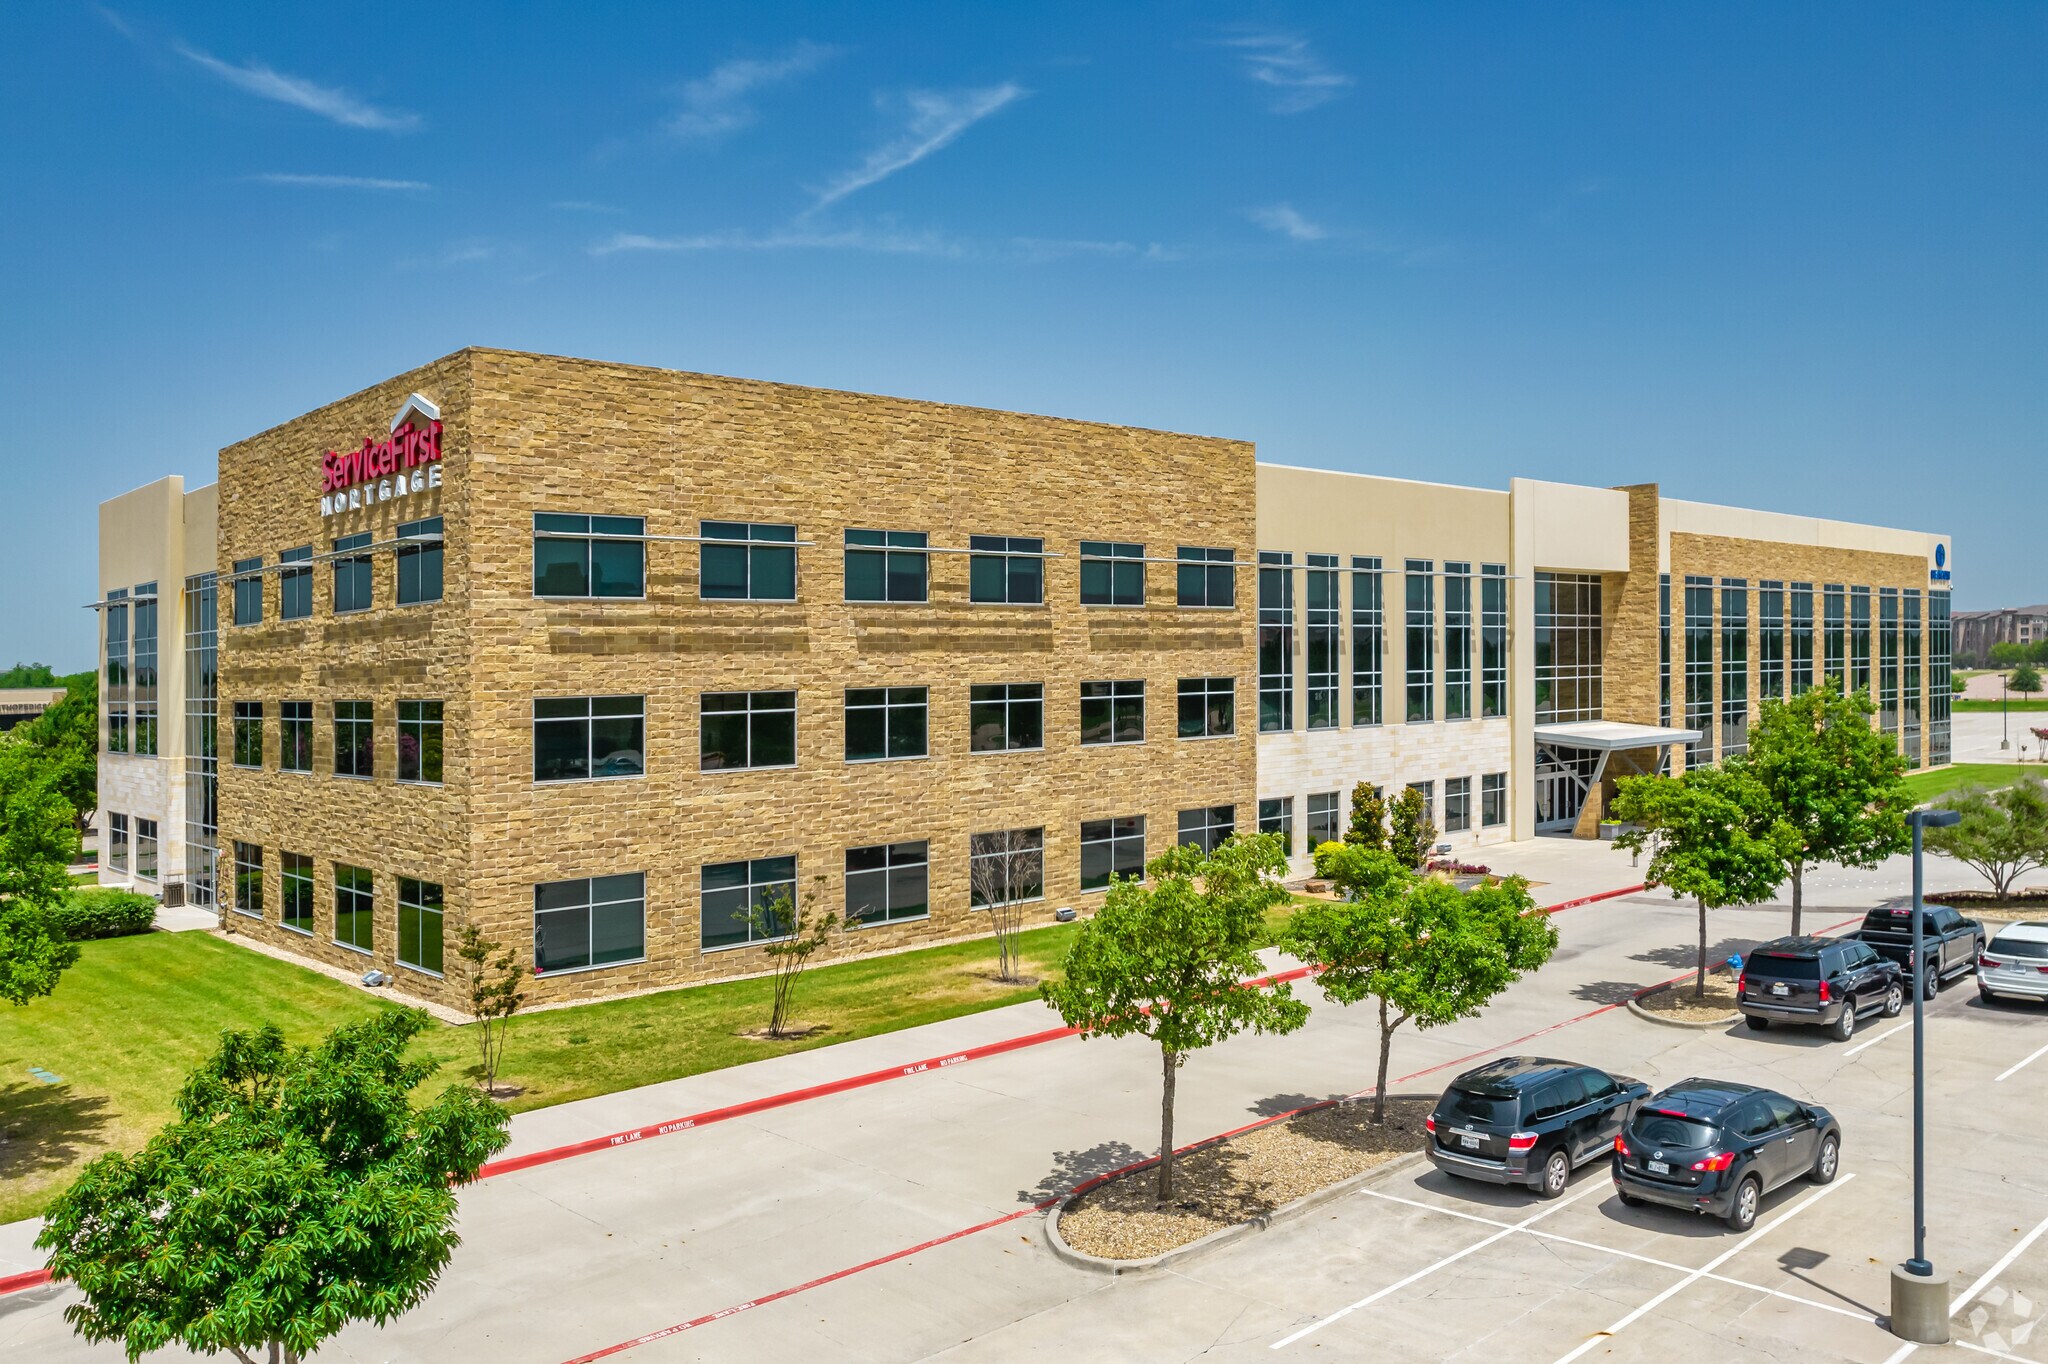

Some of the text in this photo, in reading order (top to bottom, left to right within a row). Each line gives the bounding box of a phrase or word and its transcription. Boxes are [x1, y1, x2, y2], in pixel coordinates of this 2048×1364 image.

[322, 419, 443, 492] ServiceFirst
[321, 464, 442, 517] MORTGAGE
[903, 1063, 928, 1075] FIRE LANE
[658, 1119, 695, 1135] NO PARKING
[610, 1131, 642, 1146] FIRE LANE
